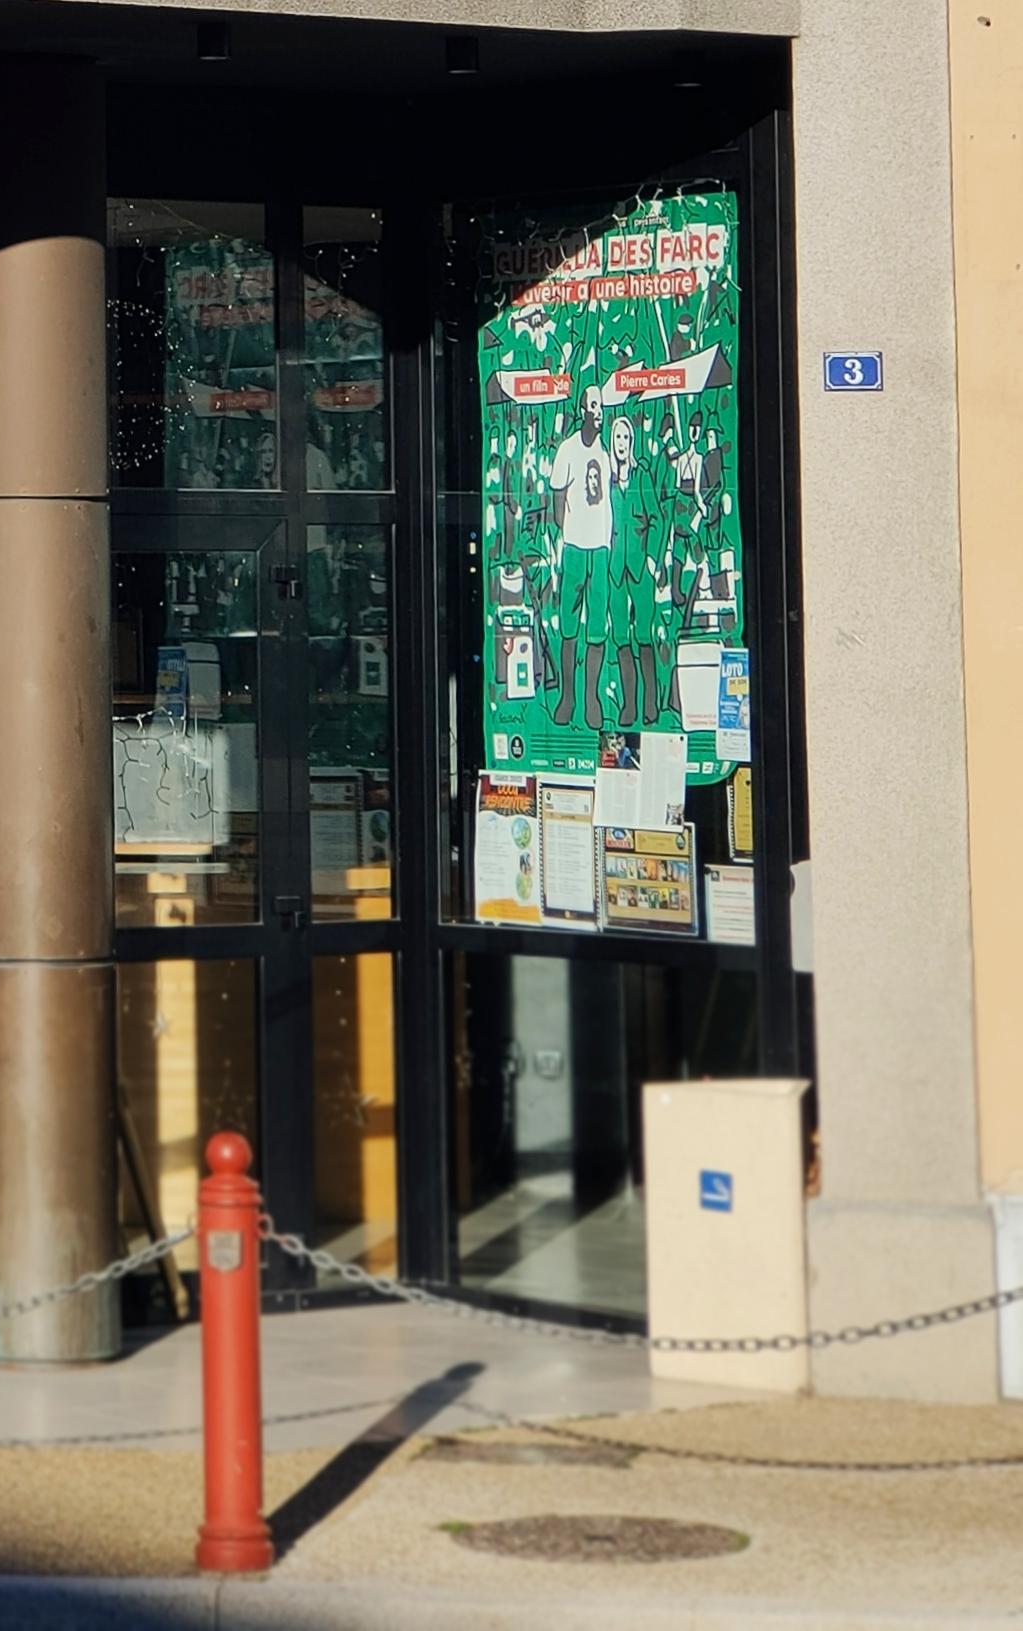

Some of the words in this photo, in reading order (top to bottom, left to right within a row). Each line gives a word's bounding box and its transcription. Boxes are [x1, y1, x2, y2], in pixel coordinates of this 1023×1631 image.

[610, 238, 651, 267] DES
[660, 232, 720, 263] FARC
[577, 282, 589, 299] a
[595, 280, 625, 299] une
[629, 275, 693, 296] histoire
[620, 374, 649, 388] Pierre
[843, 359, 864, 385] 3
[519, 382, 531, 393] un
[556, 378, 570, 391] de
[721, 662, 744, 678] LOTO
